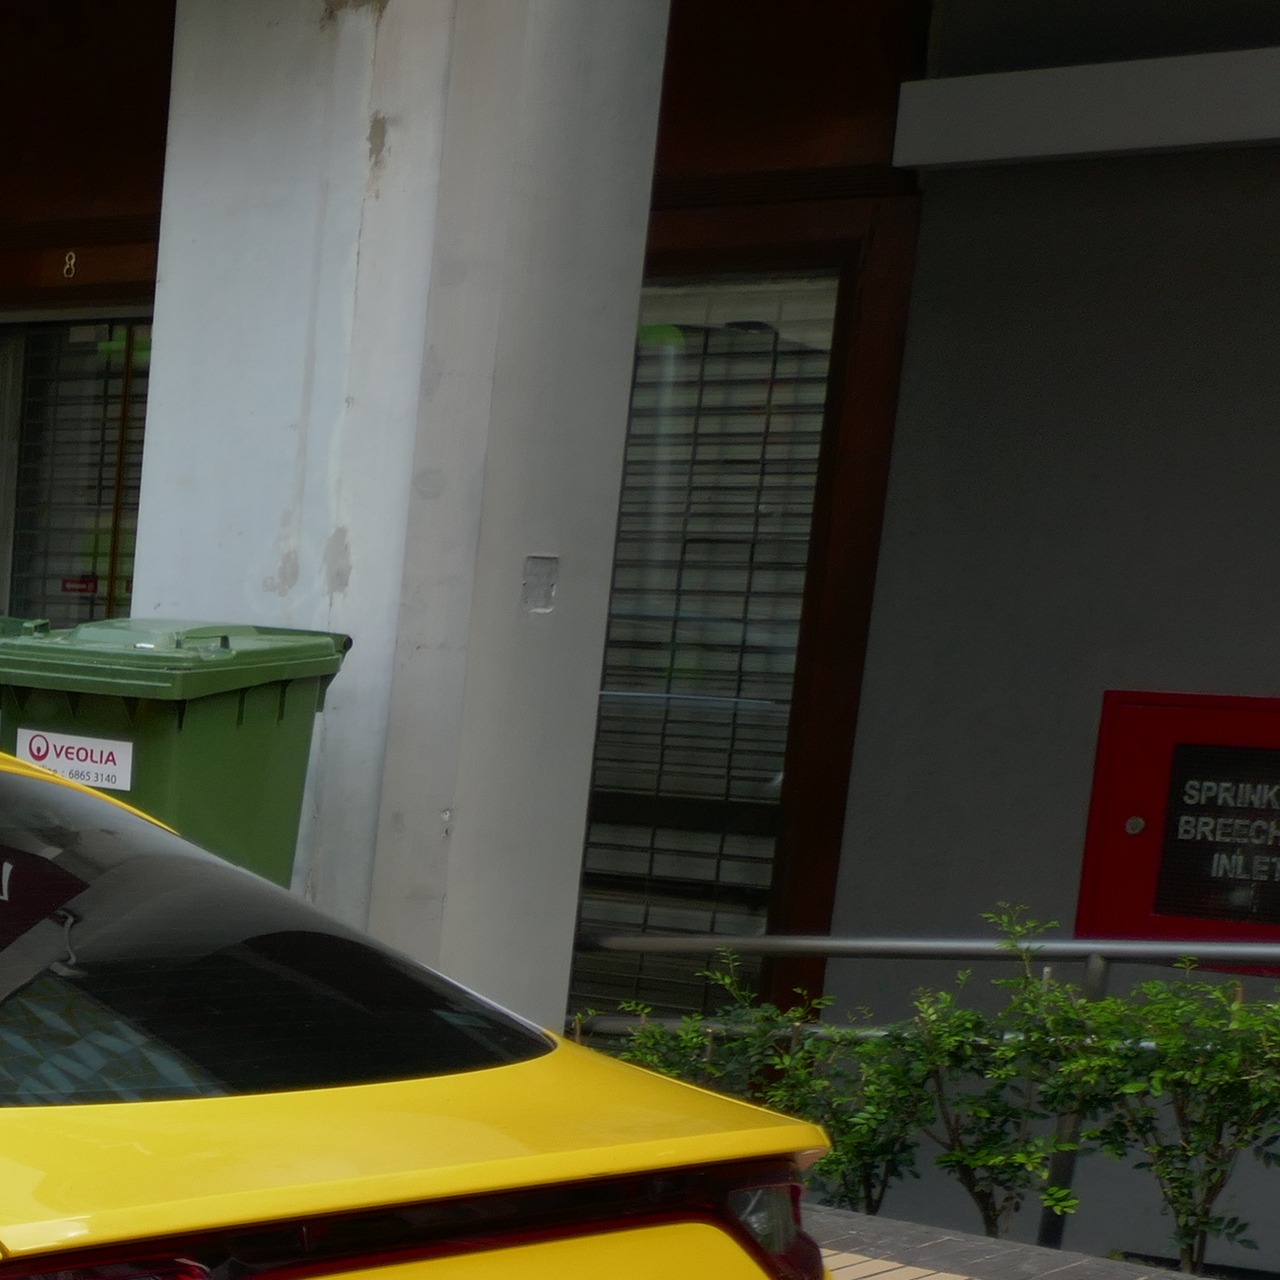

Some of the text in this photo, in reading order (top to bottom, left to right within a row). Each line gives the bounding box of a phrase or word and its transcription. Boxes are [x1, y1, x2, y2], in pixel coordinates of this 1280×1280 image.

[63, 251, 77, 278] 8
[53, 743, 117, 766] VEOLIA
[68, 769, 117, 785] 6865 3140
